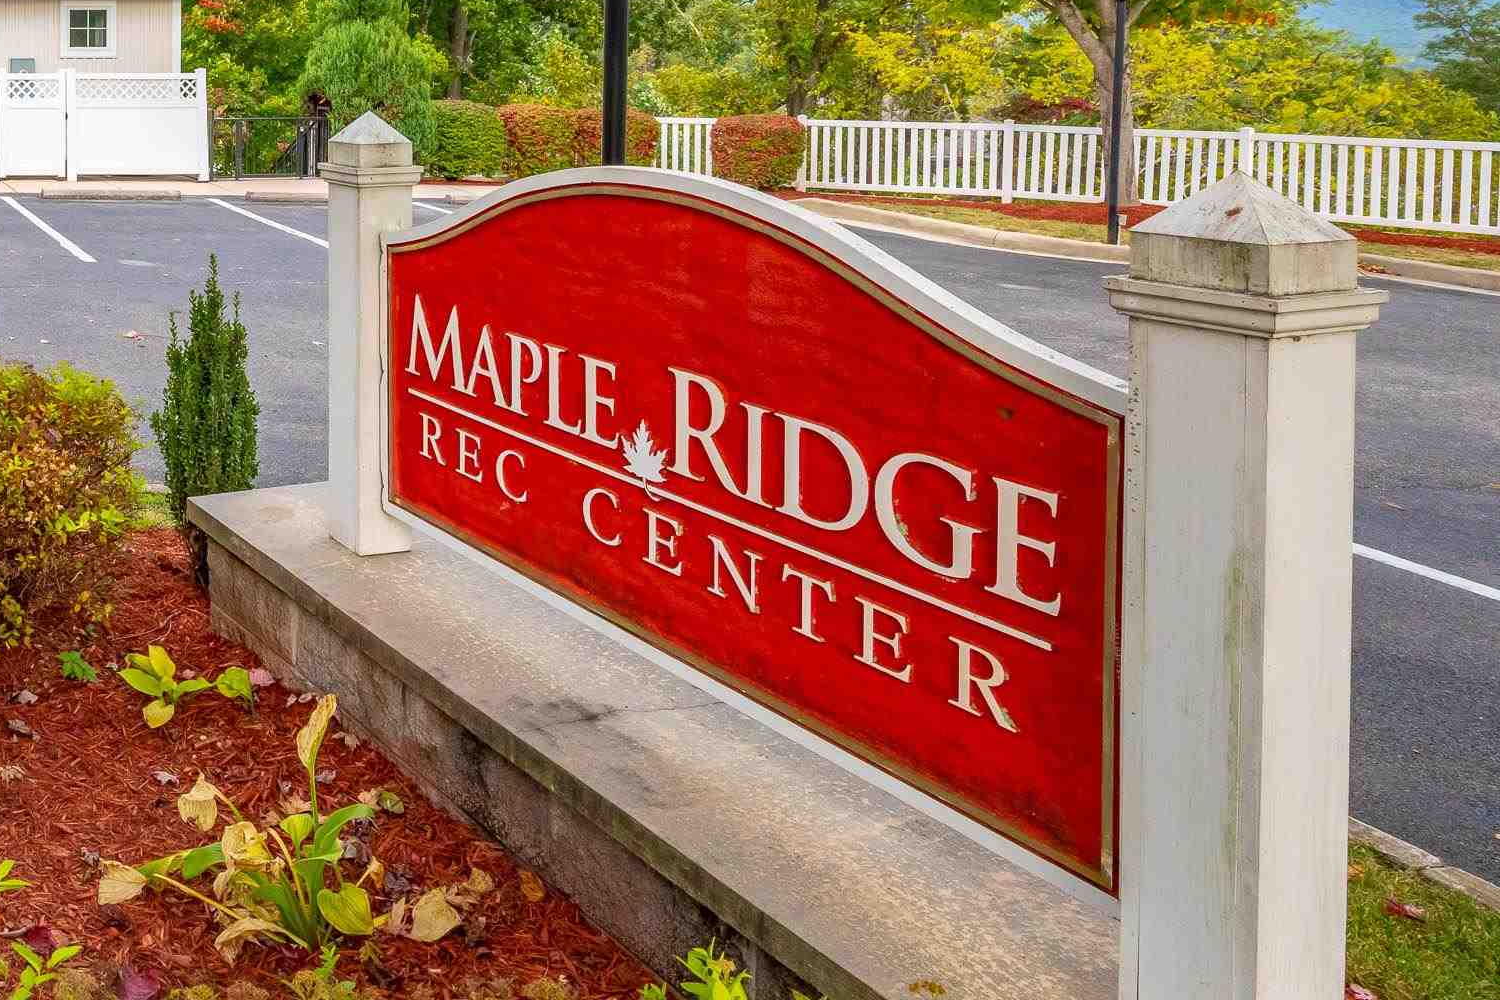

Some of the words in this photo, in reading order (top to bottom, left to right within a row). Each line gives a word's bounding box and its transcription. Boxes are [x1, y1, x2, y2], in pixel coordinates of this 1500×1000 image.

[404, 293, 620, 450] MAPLE
[667, 366, 1062, 617] RIDGE
[419, 412, 527, 503] REC
[582, 487, 1018, 733] CENTER
